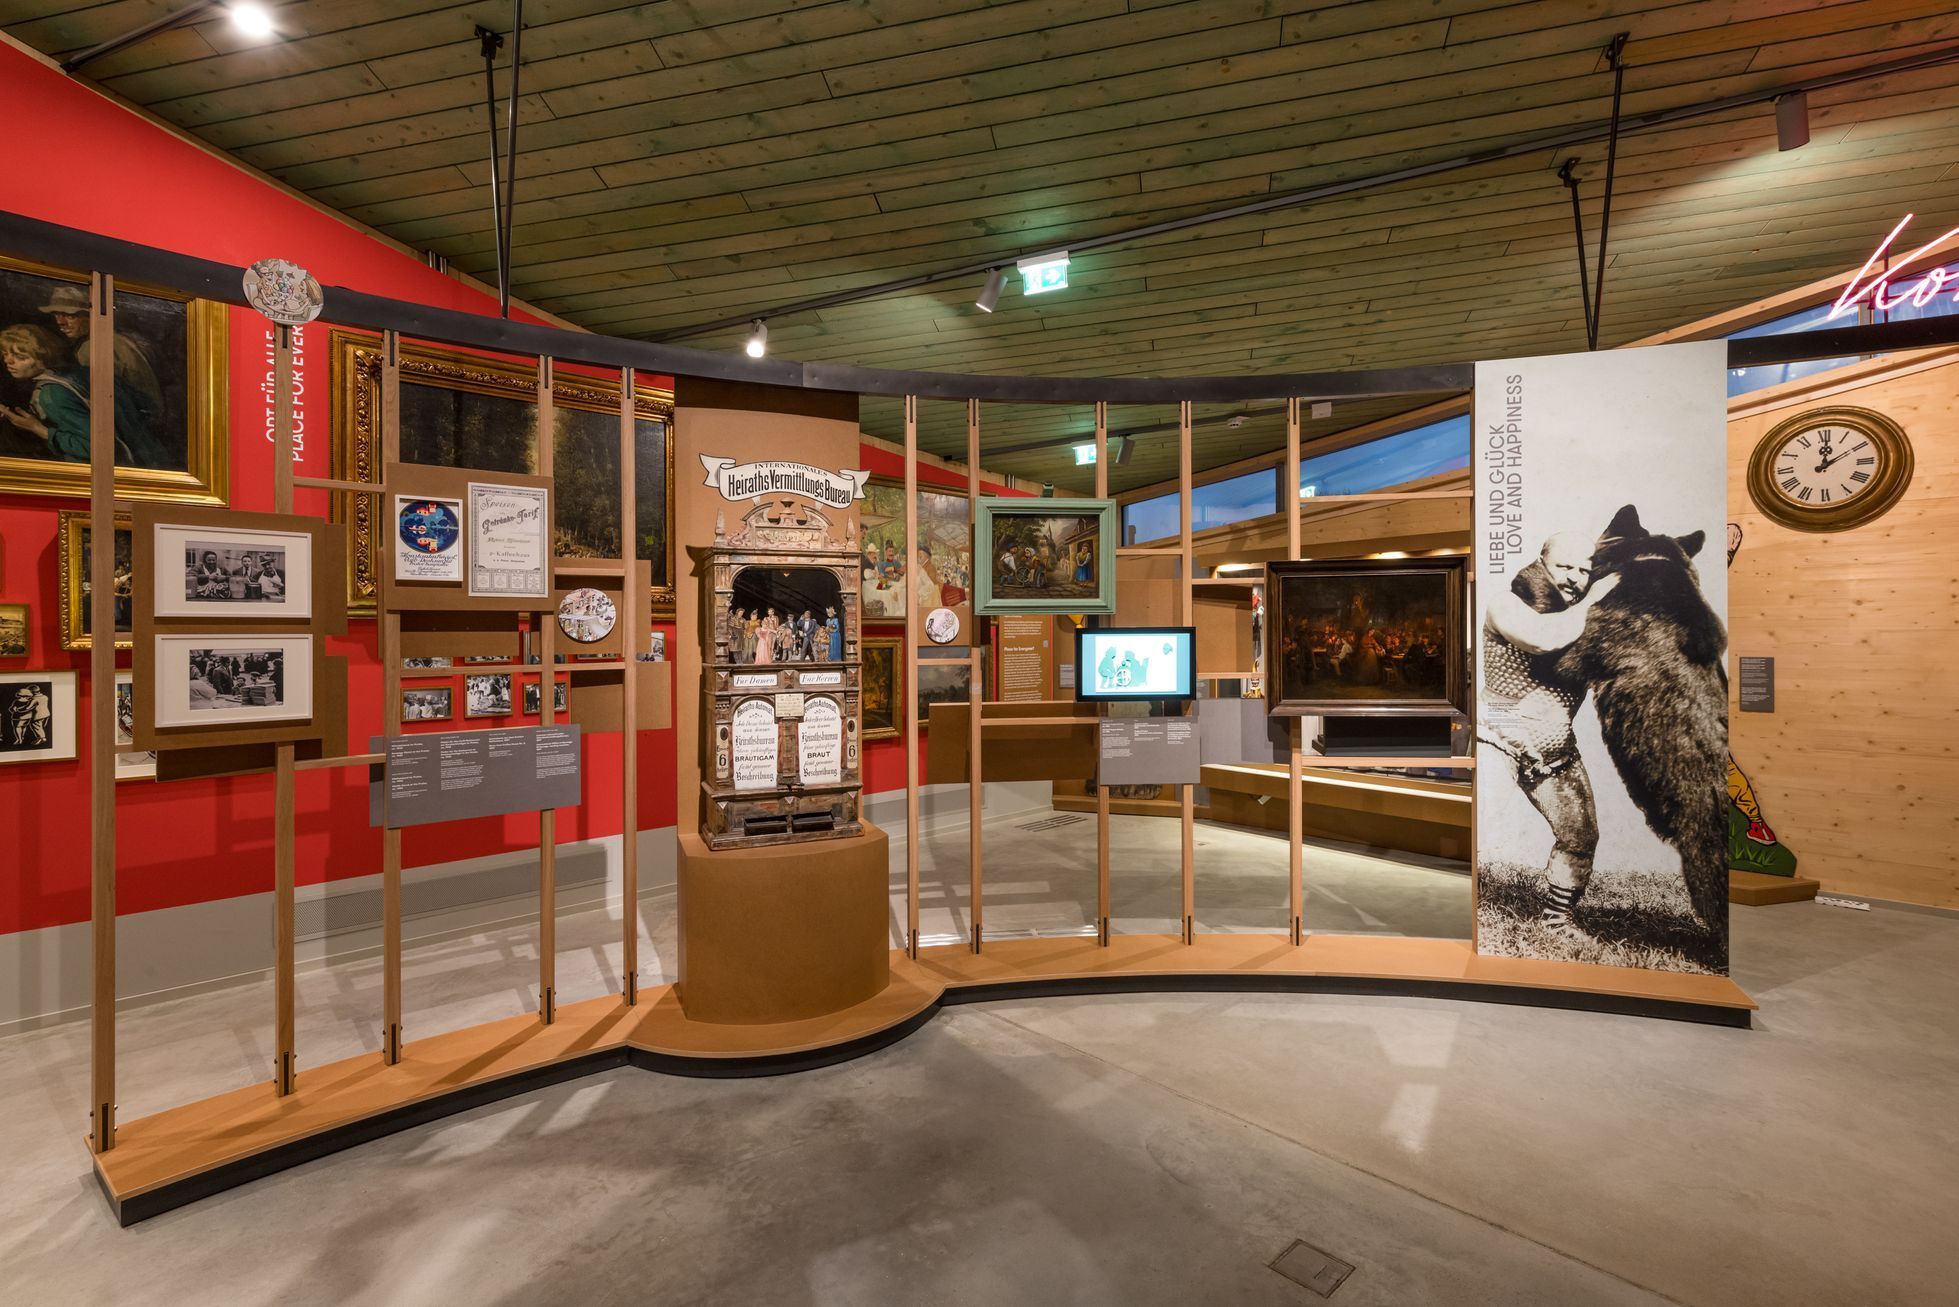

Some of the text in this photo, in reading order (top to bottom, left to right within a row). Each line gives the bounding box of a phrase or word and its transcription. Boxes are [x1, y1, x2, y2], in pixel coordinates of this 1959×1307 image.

[1827, 212, 1959, 320] Ko
[292, 370, 304, 405] FOR
[292, 411, 304, 461] PLACE
[754, 462, 828, 477] INTERNATIONALES
[1507, 374, 1522, 554] LOVE AND HAPPINESS
[728, 469, 851, 504] Heiraths Vermittlungs Bureau
[1485, 424, 1505, 574] LIEBE UND GLÜCK
[719, 753, 727, 767] 6
[807, 751, 831, 759] BRAUT
[848, 744, 856, 758] 6
